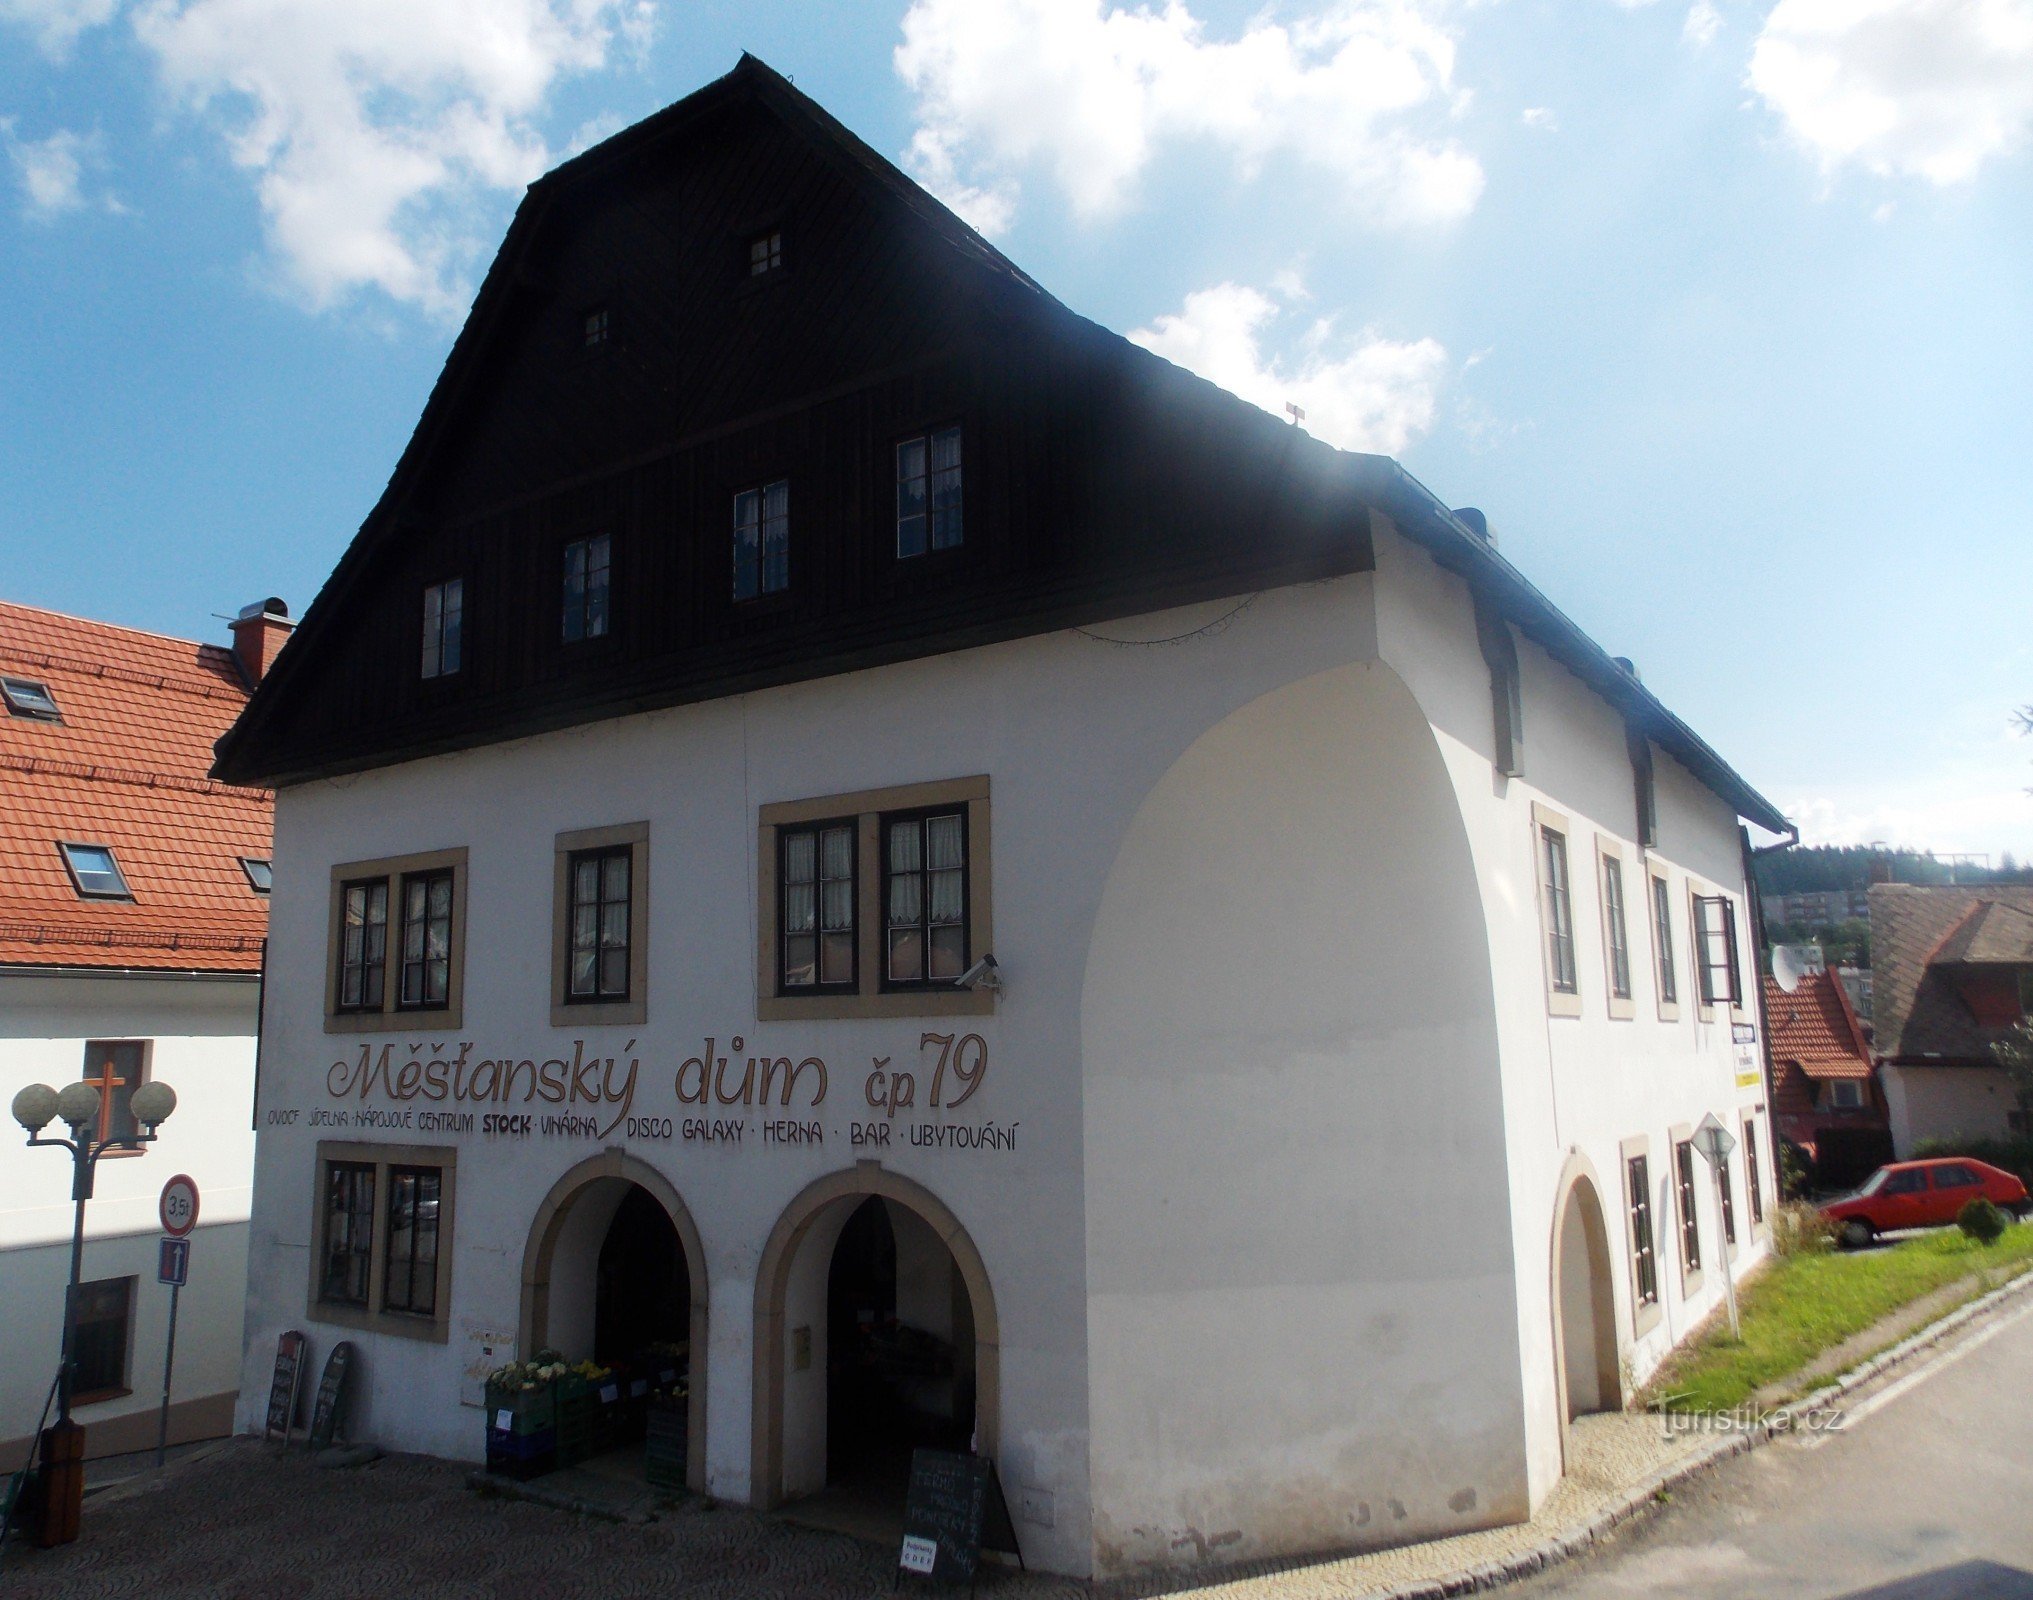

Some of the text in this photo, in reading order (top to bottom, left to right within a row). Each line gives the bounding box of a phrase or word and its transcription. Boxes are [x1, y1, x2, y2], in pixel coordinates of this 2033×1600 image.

[326, 1039, 639, 1140] Měšťanský
[674, 1036, 828, 1106] dům
[919, 1032, 988, 1109] 79
[418, 1111, 474, 1133] CENTRUM
[482, 1114, 532, 1134] STOCK
[627, 1117, 673, 1139] DISCO
[682, 1118, 745, 1142] GALAXY
[764, 1120, 823, 1144] HERNA
[850, 1122, 891, 1146] BAR
[910, 1121, 1020, 1151] UBYTOVÁNÍ
